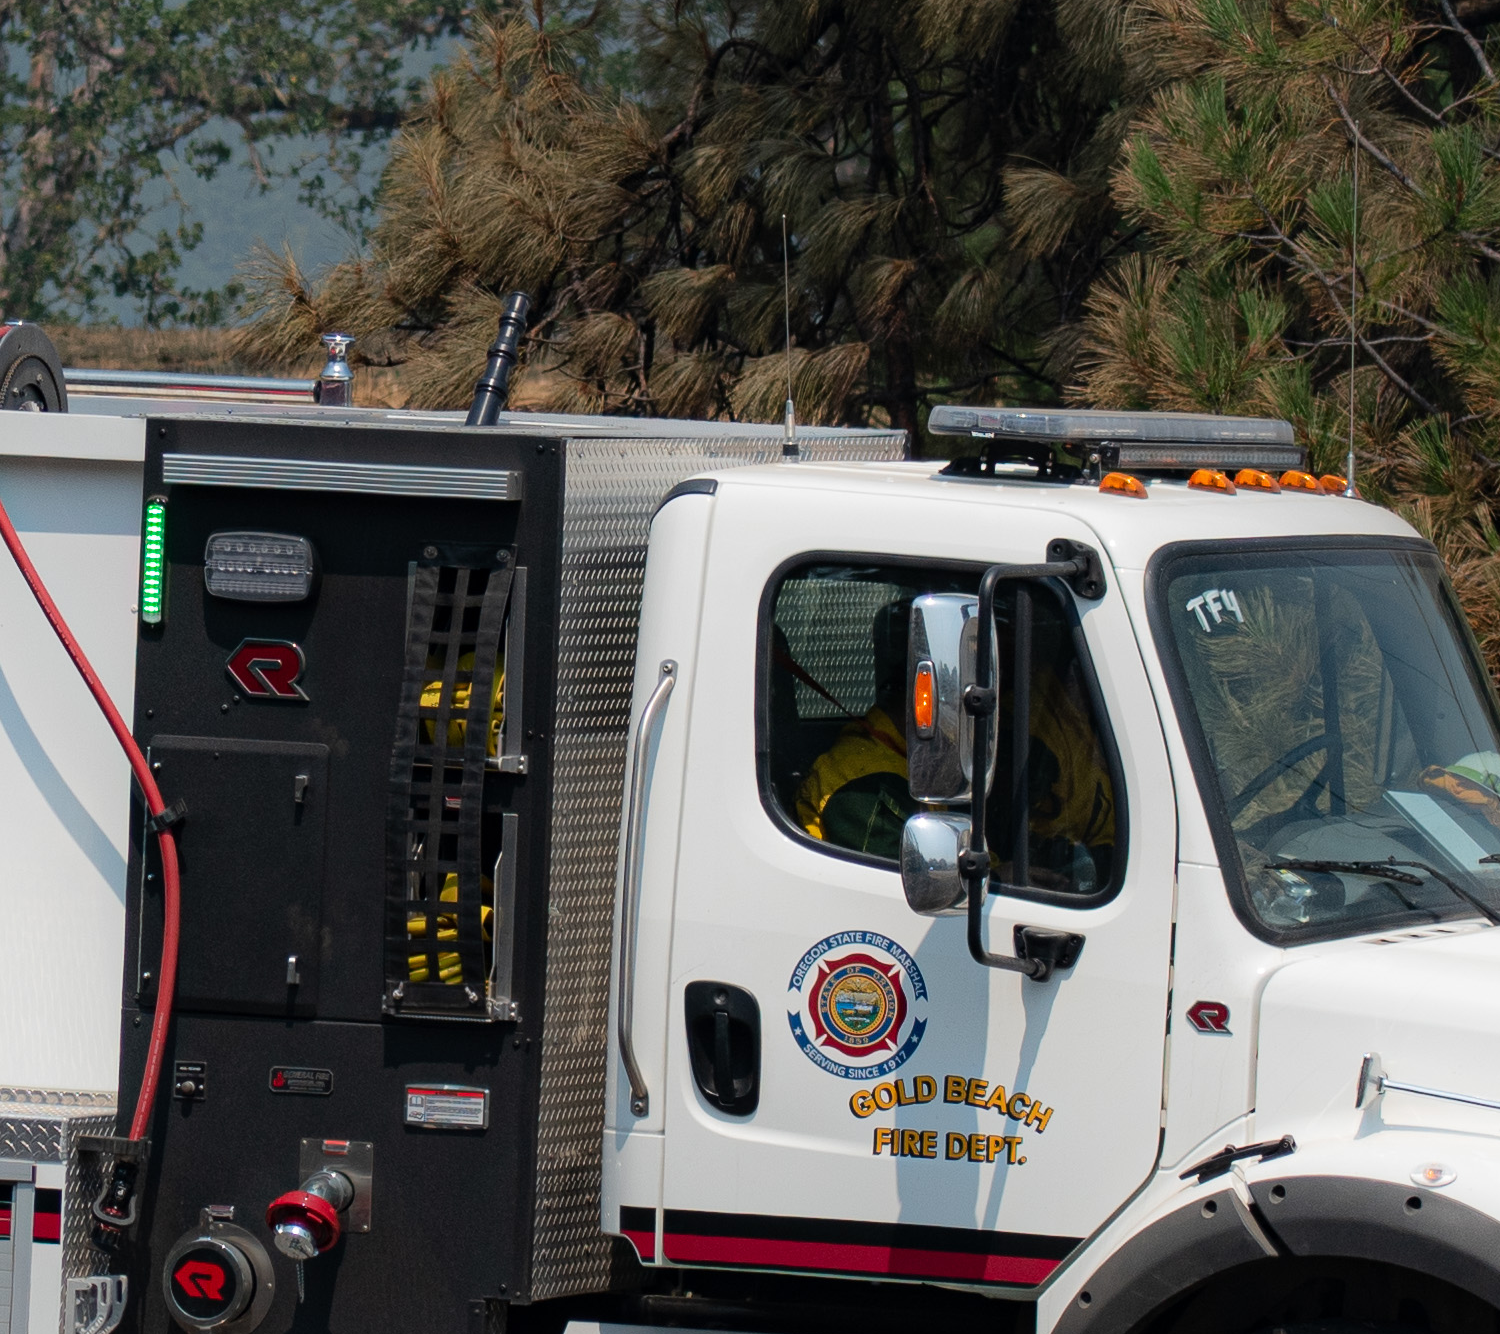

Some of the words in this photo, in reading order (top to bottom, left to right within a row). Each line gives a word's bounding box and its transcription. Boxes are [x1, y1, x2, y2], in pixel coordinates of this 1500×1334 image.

[1185, 588, 1245, 633] TF4
[792, 941, 828, 987] OREGON
[829, 932, 863, 947] STATE
[865, 932, 889, 949] FIRE
[889, 944, 924, 997] MARSHAL
[803, 1043, 847, 1077] SERVING
[848, 1067, 880, 1079] SINCE
[883, 1050, 907, 1073] 1917
[849, 1075, 938, 1119] GOLD
[943, 1074, 1055, 1134] BEACH
[872, 1127, 938, 1159] FIRE
[945, 1132, 1028, 1165] DEPT.
